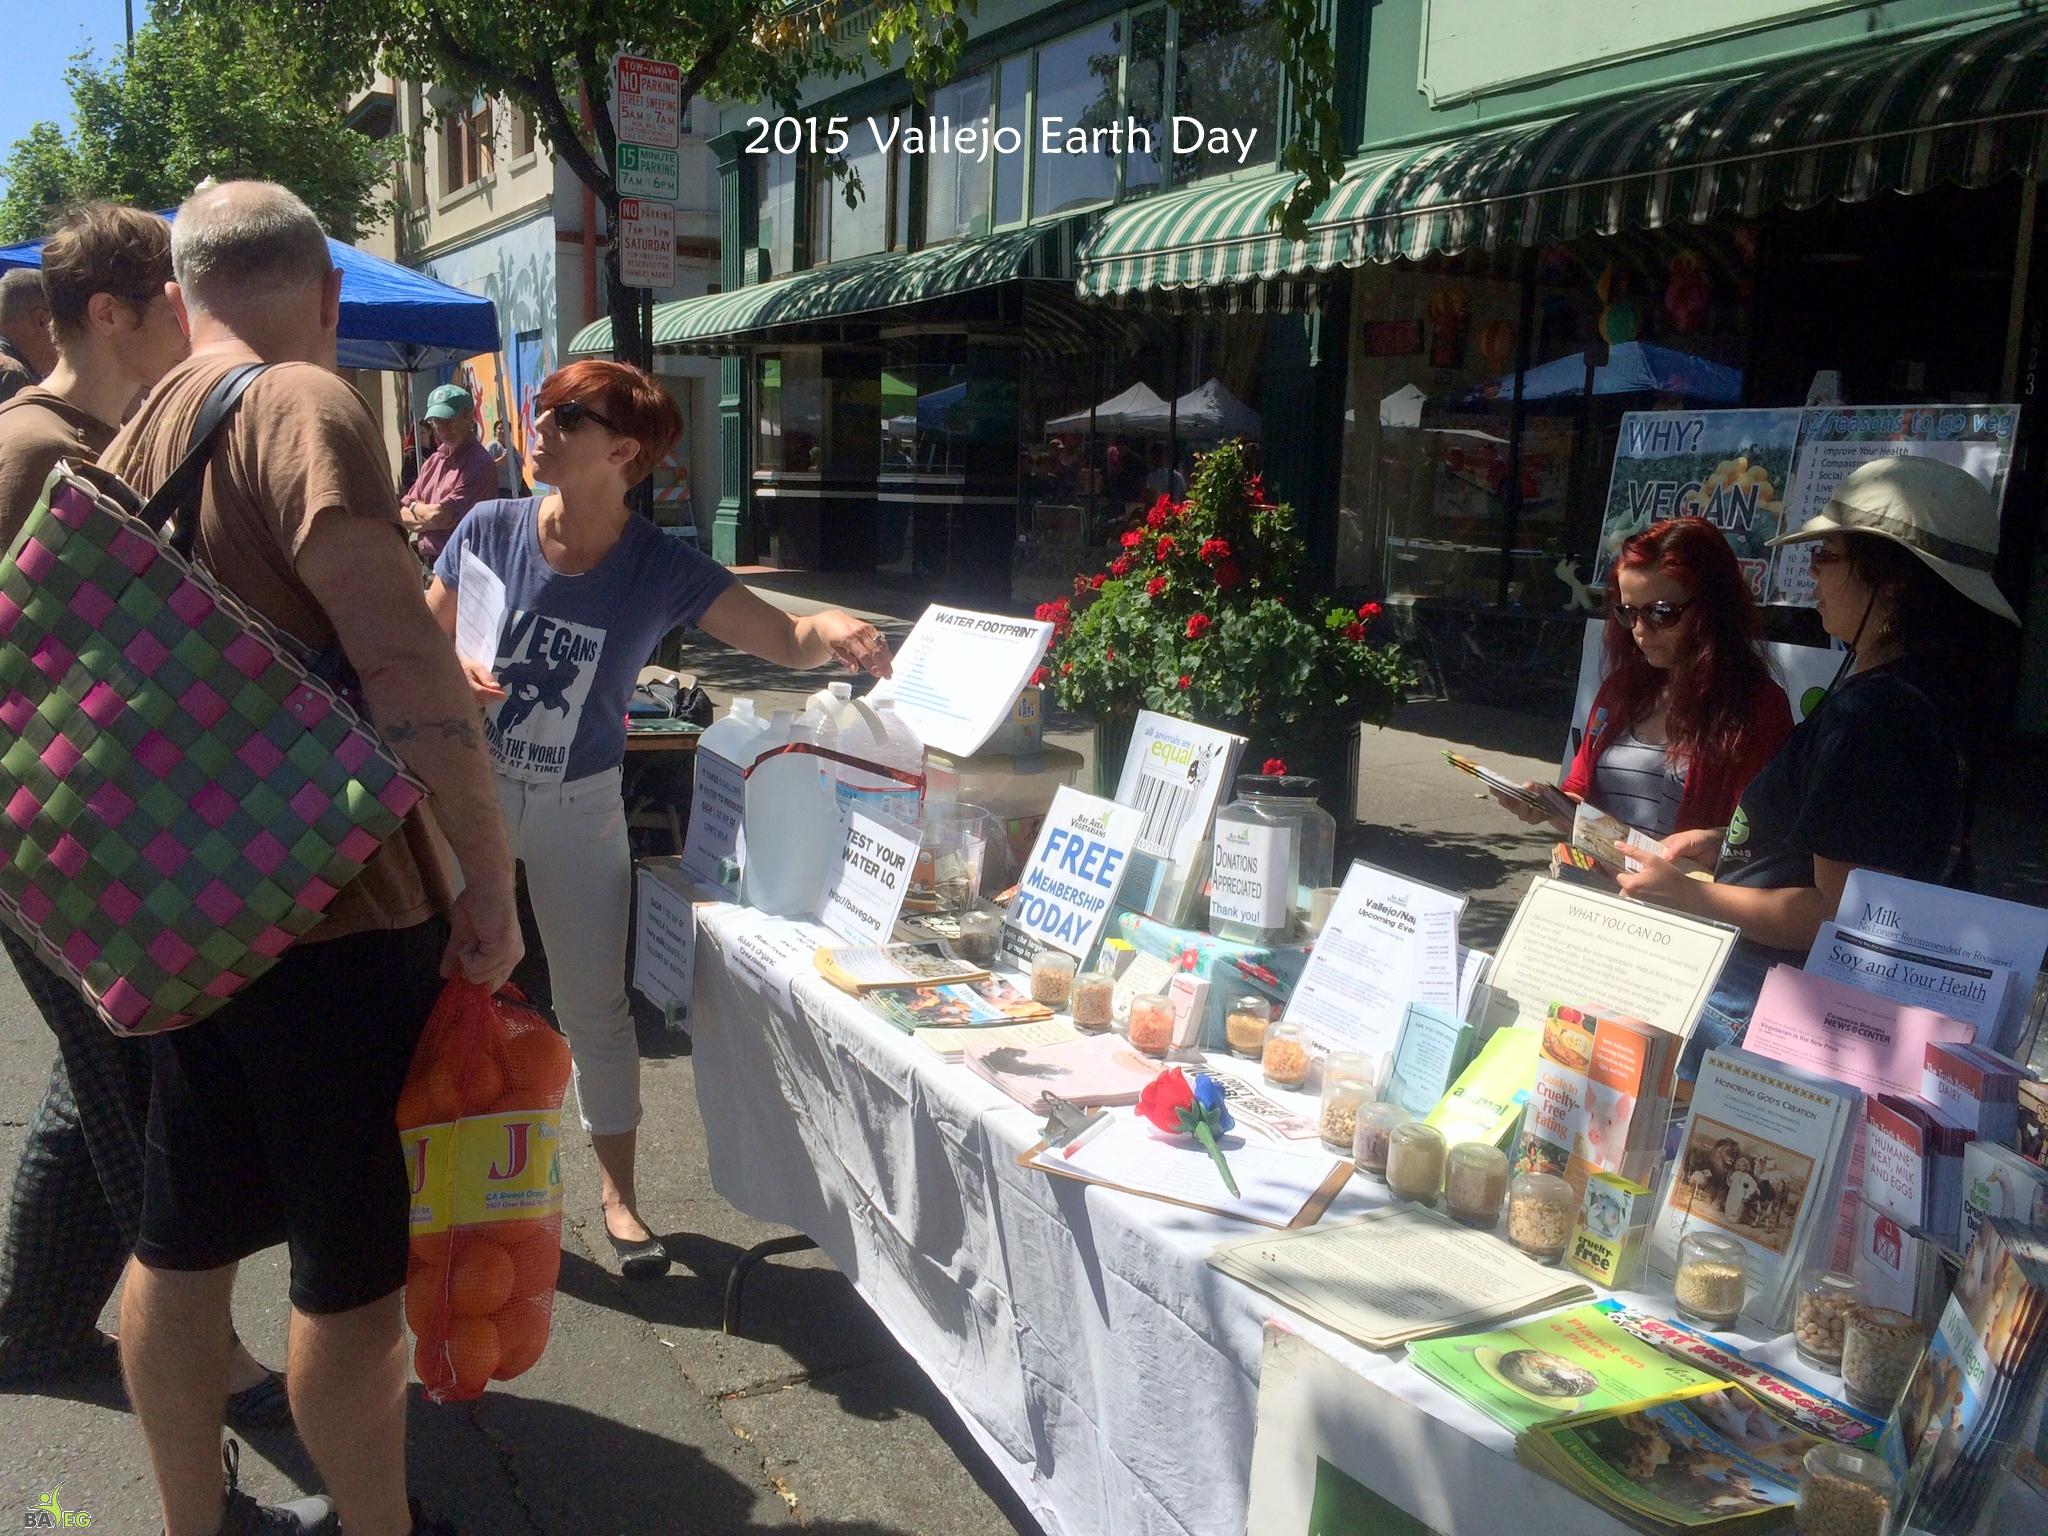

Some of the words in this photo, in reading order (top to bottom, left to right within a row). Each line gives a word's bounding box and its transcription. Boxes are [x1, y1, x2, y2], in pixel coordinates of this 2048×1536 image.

[623, 60, 675, 76] TOW-AWAY
[620, 72, 639, 92] NO
[641, 80, 677, 95] PARKING
[621, 93, 644, 104] STREET
[645, 97, 677, 112] SWEEPING
[622, 149, 636, 168] 15
[640, 151, 675, 162] MINUTE
[640, 161, 676, 176] PARKING
[622, 202, 638, 217] NO
[641, 208, 673, 221] PARKING
[625, 239, 671, 252] SATURDAY
[1626, 420, 1704, 453] WHY?
[1825, 414, 1904, 434] reasons
[1911, 413, 1934, 434] to
[1938, 414, 1967, 438] go
[1973, 414, 2012, 438] veg
[1823, 447, 1857, 457] Improve
[1859, 447, 1878, 456] Your
[1879, 447, 1909, 456] Health
[1816, 484, 1833, 492] Live
[1818, 471, 1843, 480] Social
[1627, 480, 1759, 533] VEGAN
[494, 609, 598, 663] VEGANS
[935, 612, 975, 628] WATER
[975, 620, 1039, 639] FOOTPRINT
[1144, 727, 1153, 736] all
[1154, 731, 1180, 744] animals
[506, 738, 527, 760] THE
[528, 742, 566, 765] WORLD
[1151, 740, 1195, 767] equal
[509, 760, 522, 769] AT
[523, 763, 531, 771] A
[1071, 818, 1106, 838] VEGETARIANS
[1089, 818, 1103, 830] AREA
[847, 827, 873, 852] TEST
[876, 843, 906, 871] YOUR
[1040, 827, 1124, 889] FREE
[1216, 845, 1258, 874] DONATIONS
[842, 846, 880, 879] WATER
[1027, 866, 1105, 914] MEMBERSHIP
[1213, 868, 1262, 899] APPRECIATED
[1016, 890, 1092, 946] TODAY
[1212, 902, 1238, 918] Thank
[1240, 907, 1260, 922] you!
[1358, 908, 1396, 929] Upcoming
[1862, 902, 1902, 929] Milk
[1017, 933, 1027, 944] the
[1568, 905, 1599, 923] WHAT
[1602, 916, 1627, 932] YOU
[1627, 924, 1651, 939] CAN
[1653, 932, 1671, 946] DO
[1859, 921, 1871, 932] No
[1871, 924, 1900, 941] Longer
[1900, 931, 1962, 957] Recommended
[1962, 950, 1971, 958] or
[1829, 945, 1863, 973] Soy
[1866, 961, 1898, 980] and
[1902, 967, 1936, 989] Your
[1938, 977, 1987, 1001] Health
[1824, 1018, 1852, 1033] NEWS
[1858, 1029, 1890, 1044] CENTER
[1827, 1012, 1859, 1027] Common
[1761, 1022, 1792, 1038] Vegetarian
[1799, 1035, 1810, 1043] the
[1811, 1038, 1823, 1048] New
[1926, 1063, 1937, 1076] The
[1537, 1082, 1580, 1112] Cruelty-
[1543, 1072, 1568, 1091] Guide
[1568, 1083, 1578, 1096] to
[1938, 1082, 1962, 1103] DAIRY
[1543, 1100, 1566, 1121] Free
[1715, 1076, 1755, 1097] HONORING
[1757, 1092, 1781, 1106] GOD'S
[1783, 1101, 1817, 1121] CREATION
[1536, 1112, 1568, 1140] Eating
[488, 1123, 533, 1180] J
[1872, 1133, 1914, 1167] "HUMANE"
[1870, 1165, 1889, 1184] AND
[1890, 1175, 1913, 1200] EGGS
[1896, 1162, 1914, 1184] MILK
[1574, 1244, 1610, 1270] free
[1578, 1236, 1613, 1258] cruelty-
[1550, 1323, 1563, 1332] a
[1562, 1332, 1606, 1361] Plate
[1567, 1318, 1620, 1355] Planet
[1621, 1354, 1647, 1370] on
[1641, 1319, 1699, 1346] EAT
[1688, 1345, 1758, 1378] MORE
[1949, 1309, 1964, 1348] Why
[1963, 1334, 1985, 1386] Vegan
